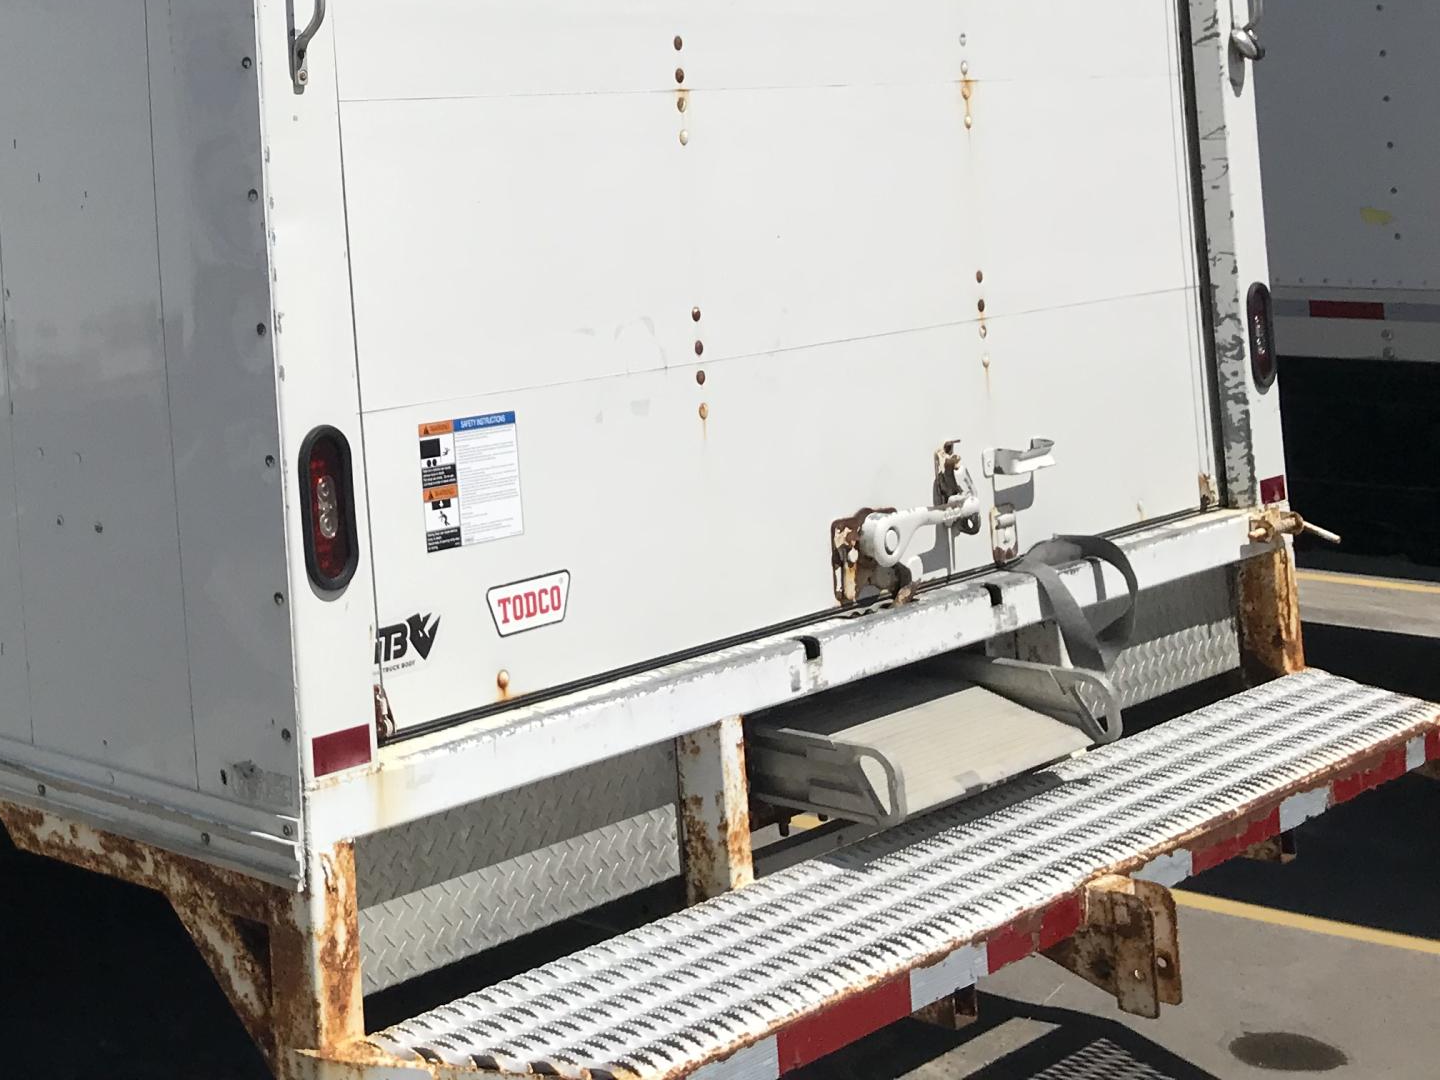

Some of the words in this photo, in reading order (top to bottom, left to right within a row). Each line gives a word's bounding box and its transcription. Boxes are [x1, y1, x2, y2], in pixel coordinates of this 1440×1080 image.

[460, 418, 476, 429] SAFETY
[477, 414, 506, 426] INSTRUCTIONS
[497, 585, 562, 624] TODCO
